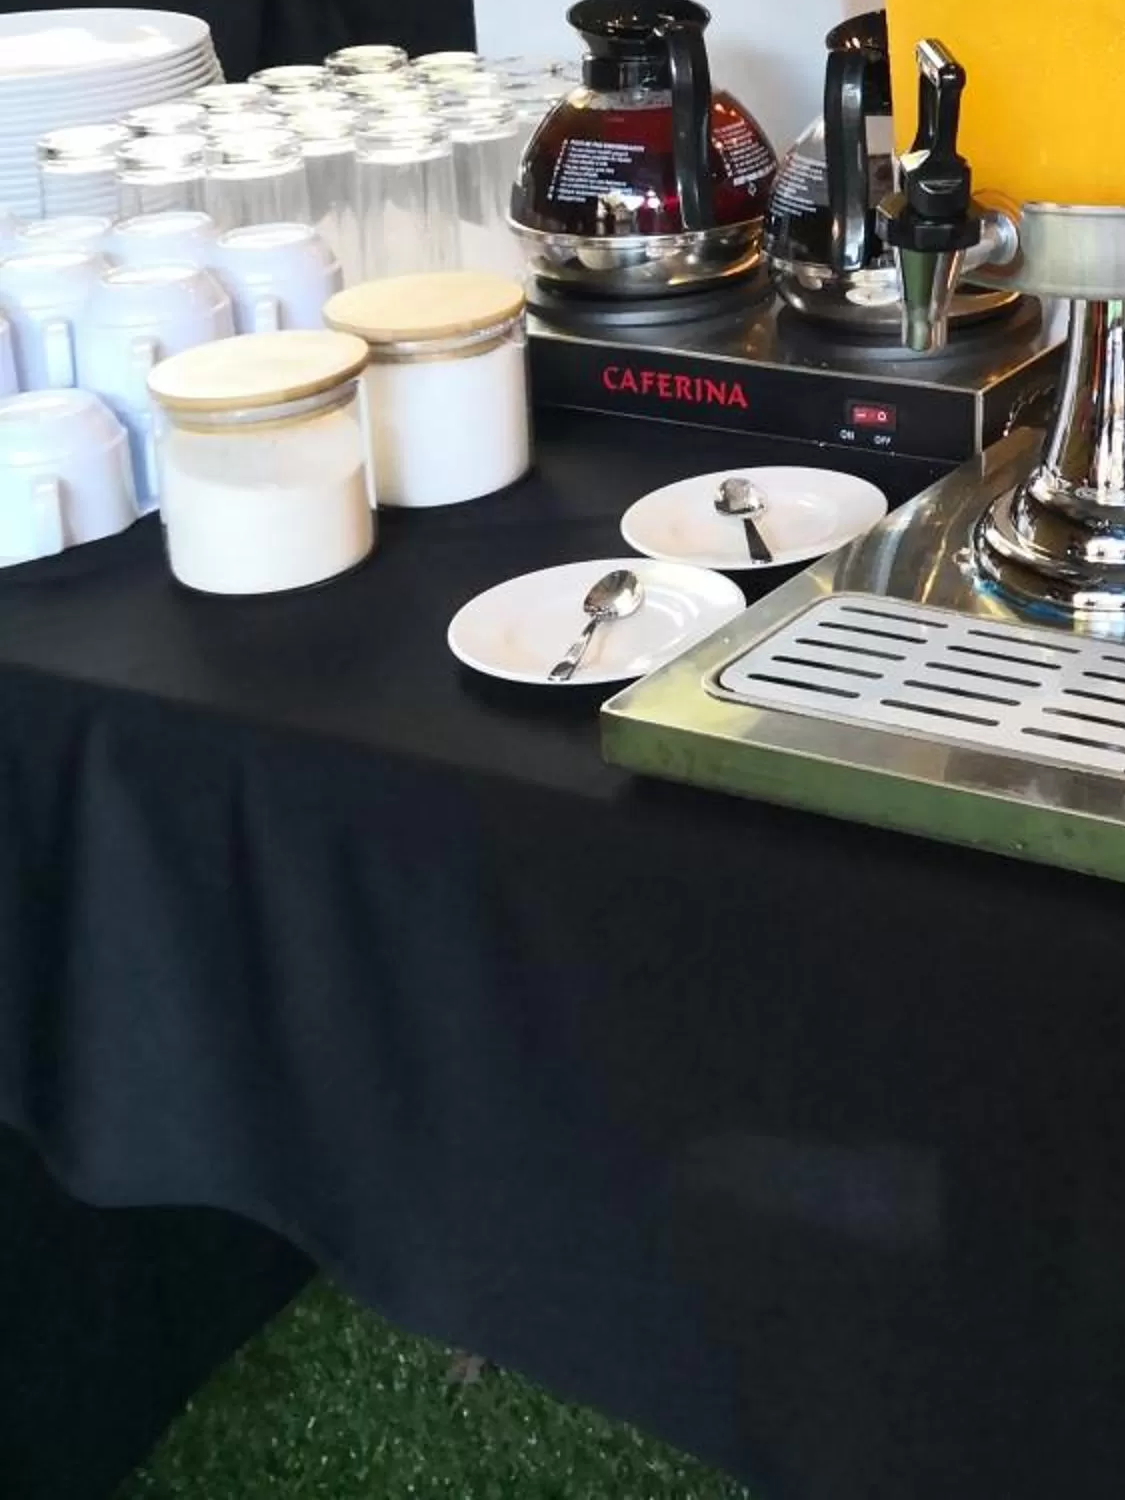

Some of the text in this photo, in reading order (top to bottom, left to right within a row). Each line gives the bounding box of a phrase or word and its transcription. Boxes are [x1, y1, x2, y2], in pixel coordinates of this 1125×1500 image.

[602, 365, 748, 409] CAFERINA
[840, 429, 891, 446] ON OFF
